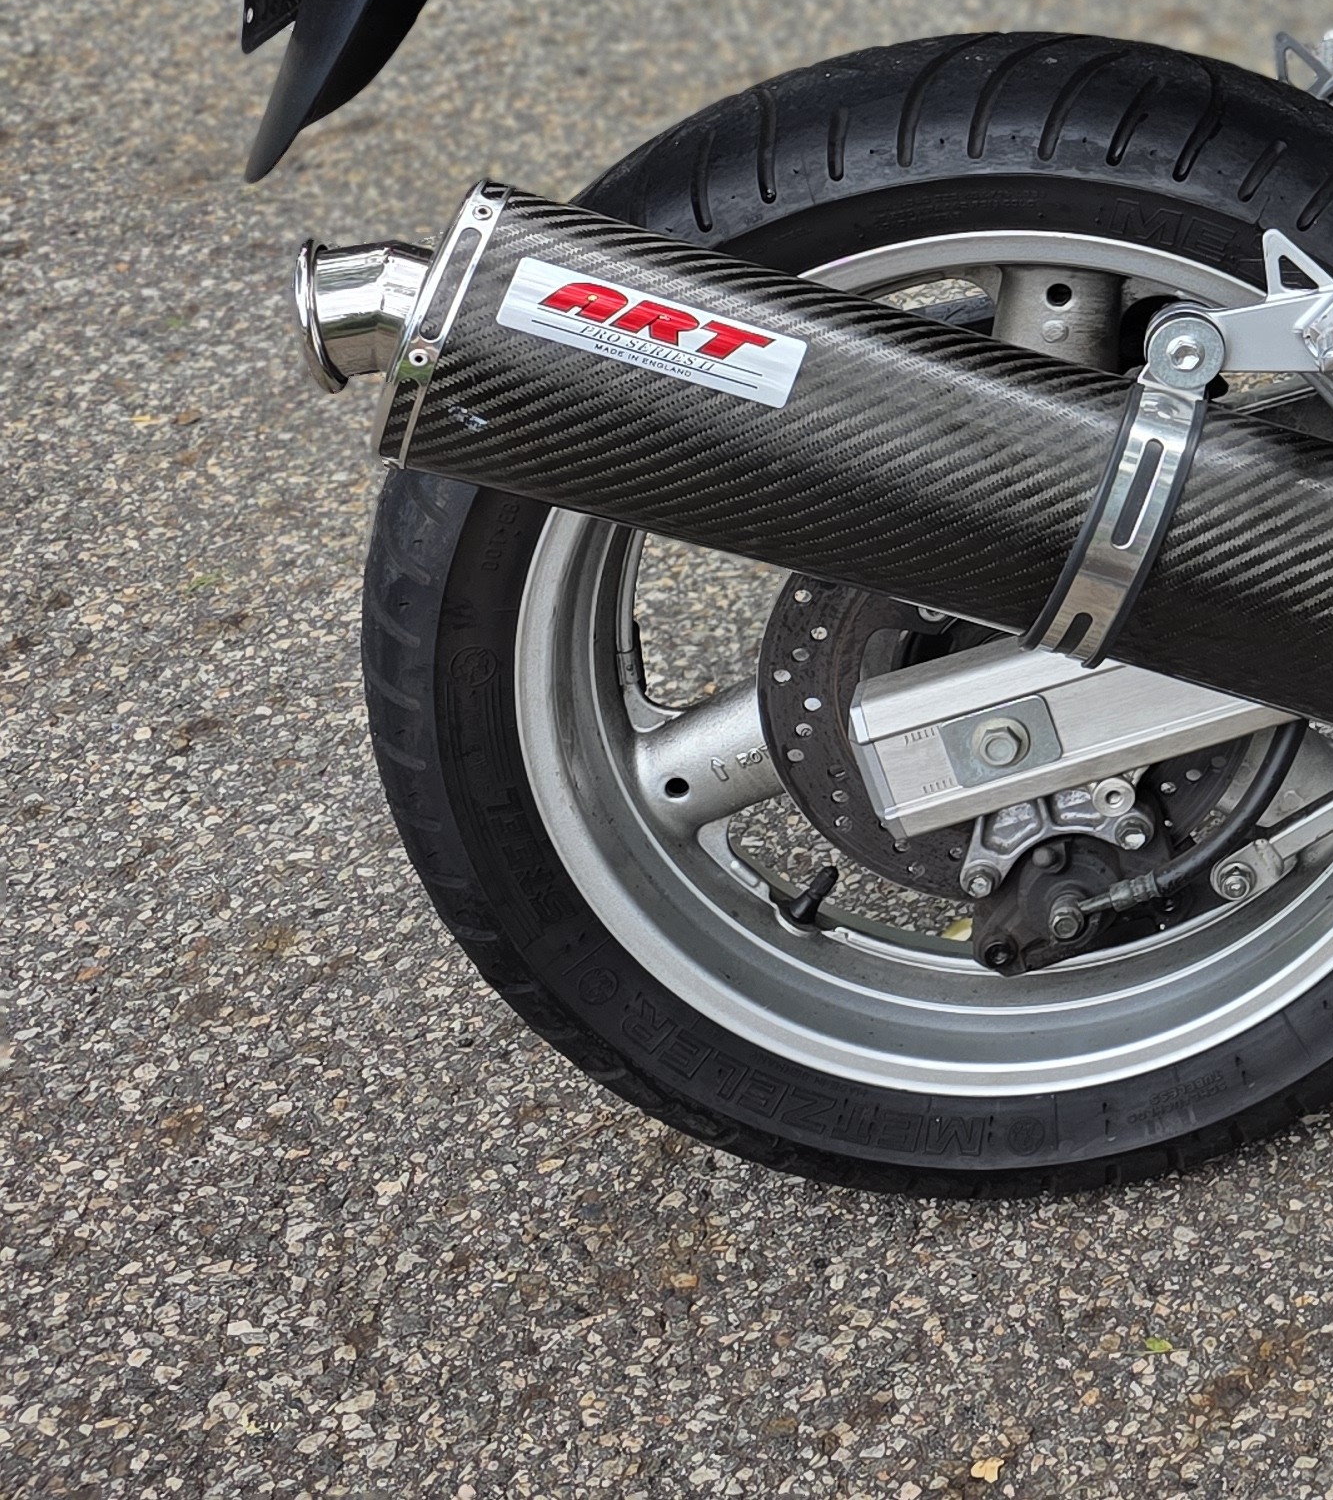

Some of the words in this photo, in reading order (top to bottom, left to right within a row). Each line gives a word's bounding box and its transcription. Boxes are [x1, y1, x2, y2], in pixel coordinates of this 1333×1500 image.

[538, 282, 776, 360] ART
[580, 325, 620, 345] PRO
[625, 338, 703, 370] SERIES
[700, 361, 716, 372] II
[594, 343, 625, 359] MADE
[627, 355, 640, 364] IN
[641, 358, 692, 378] ENGLAND
[620, 995, 988, 1157] METZELER
[1149, 1071, 1225, 1104] TUBELESS
